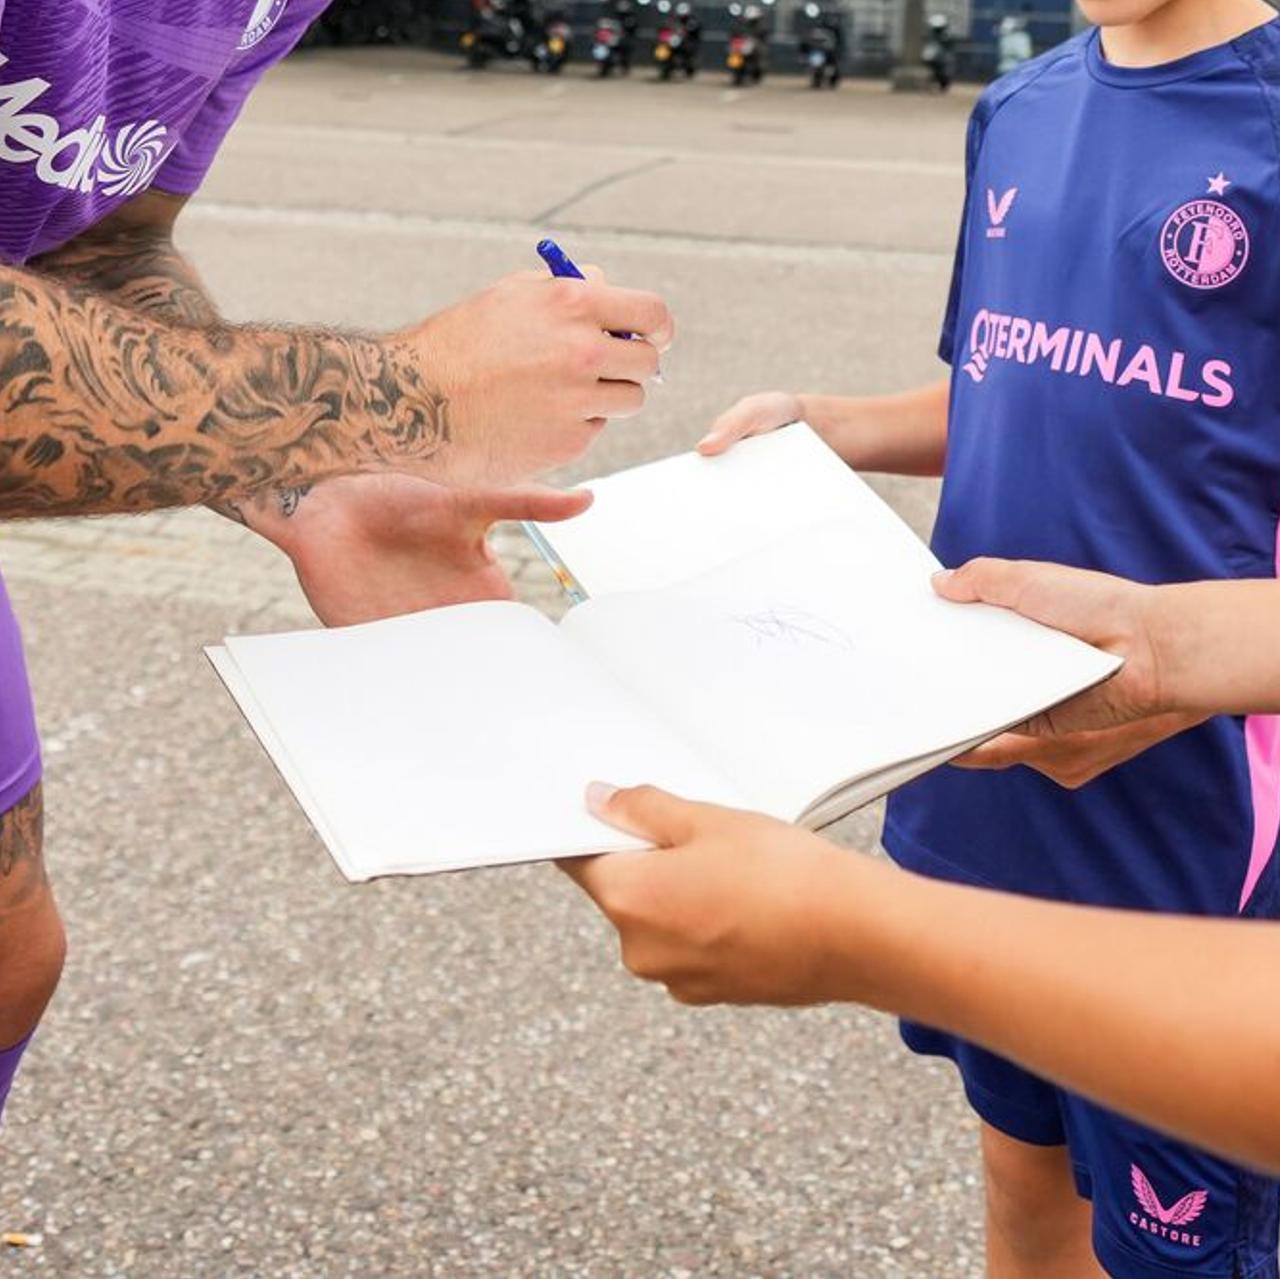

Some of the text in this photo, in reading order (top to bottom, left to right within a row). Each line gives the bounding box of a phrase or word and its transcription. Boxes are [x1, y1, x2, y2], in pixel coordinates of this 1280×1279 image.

[1173, 203, 1245, 241] FEYENOORD
[1164, 249, 1238, 285] ROTTERDAM
[963, 308, 1235, 407] QTERMINALS
[1129, 1211, 1202, 1247] CASTORE
